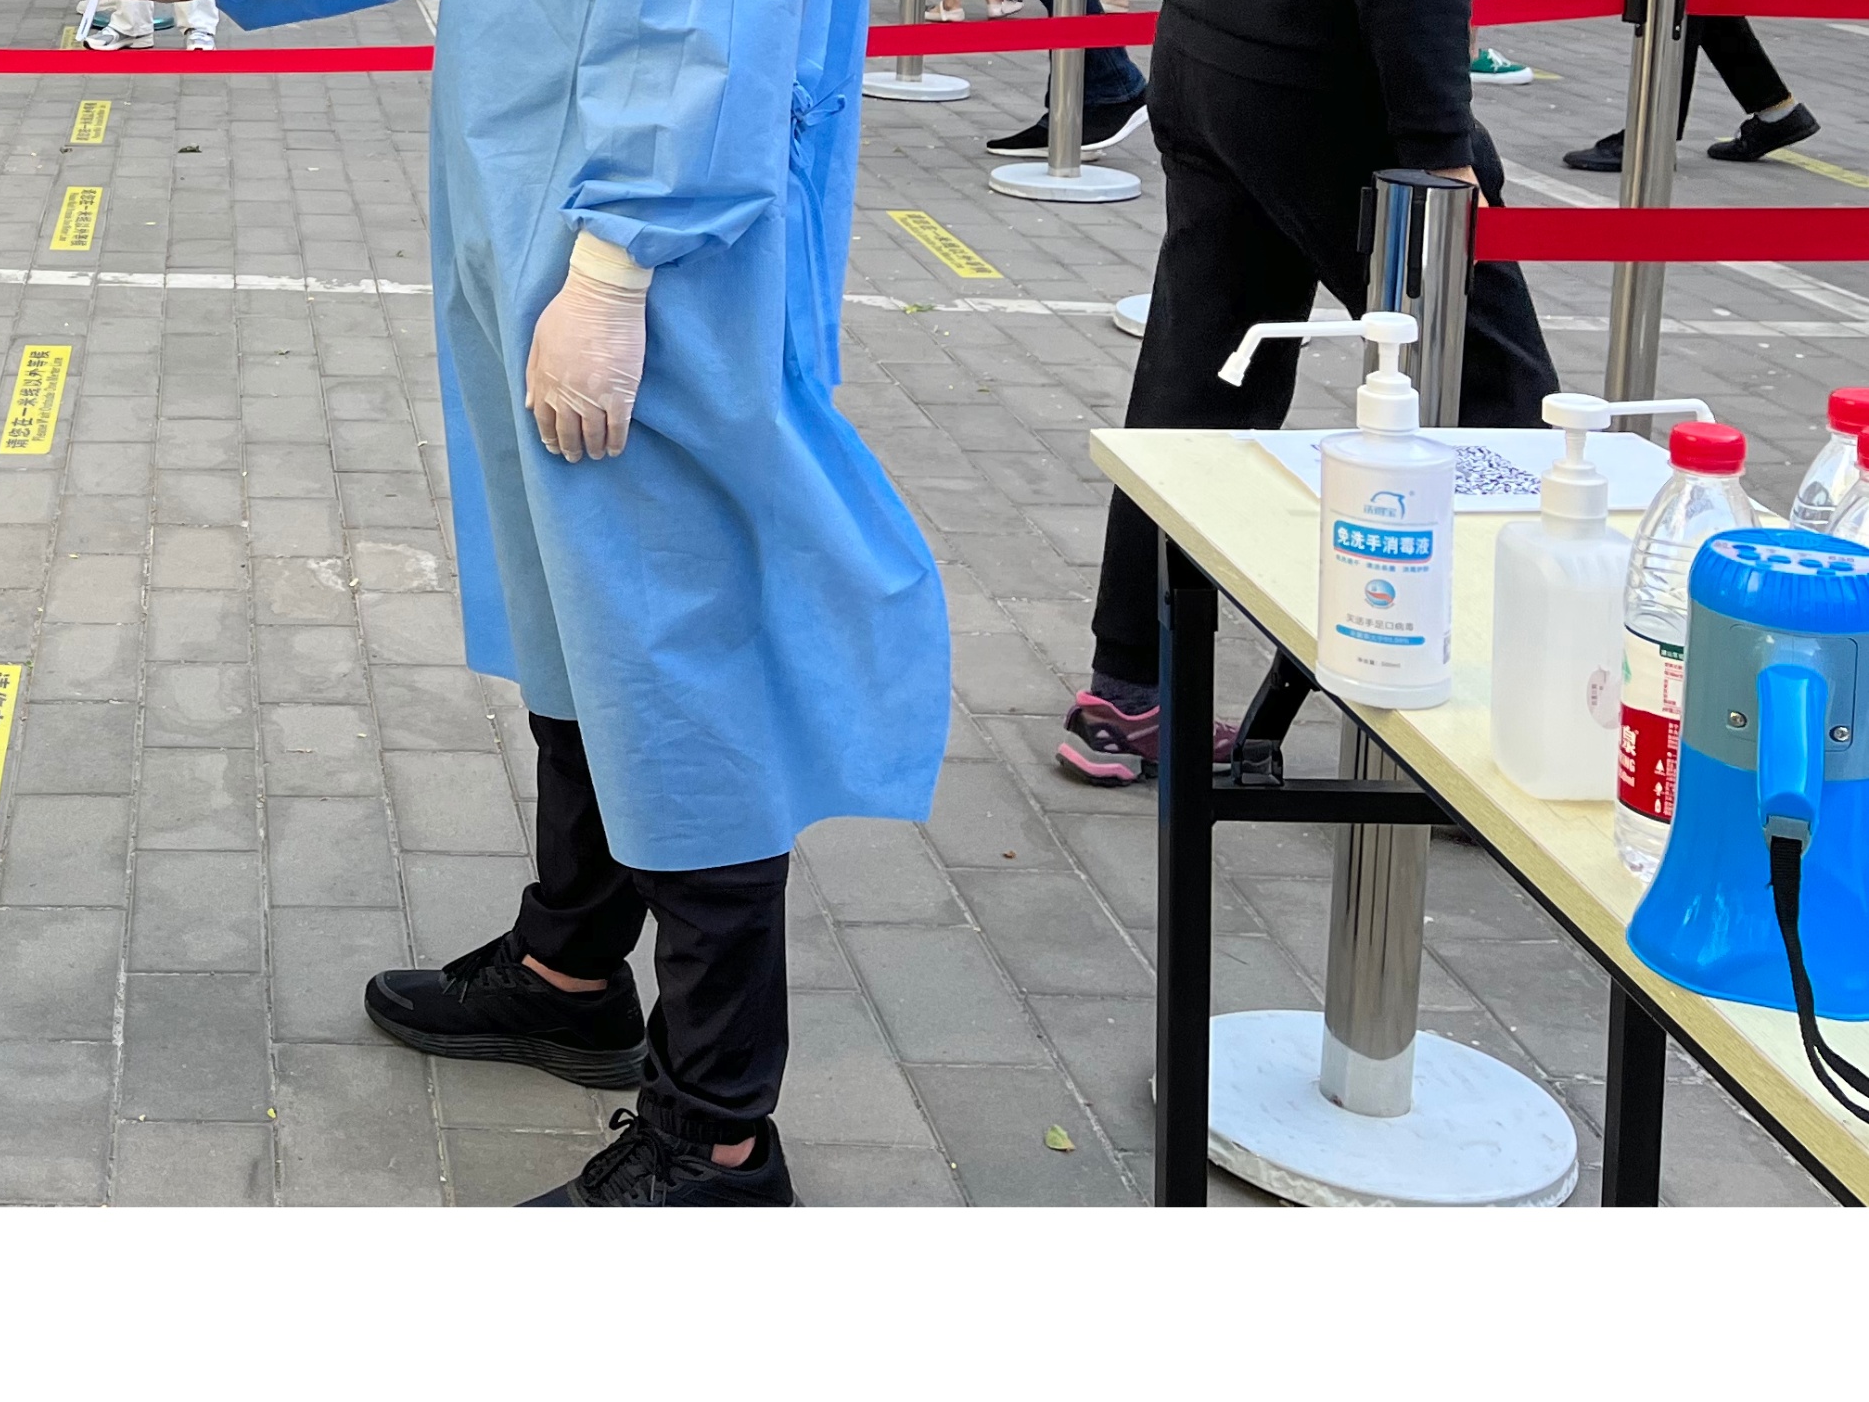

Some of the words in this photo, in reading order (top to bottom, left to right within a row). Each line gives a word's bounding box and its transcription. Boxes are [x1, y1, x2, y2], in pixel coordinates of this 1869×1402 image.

[1337, 527, 1429, 556] 免洗手消毒液
